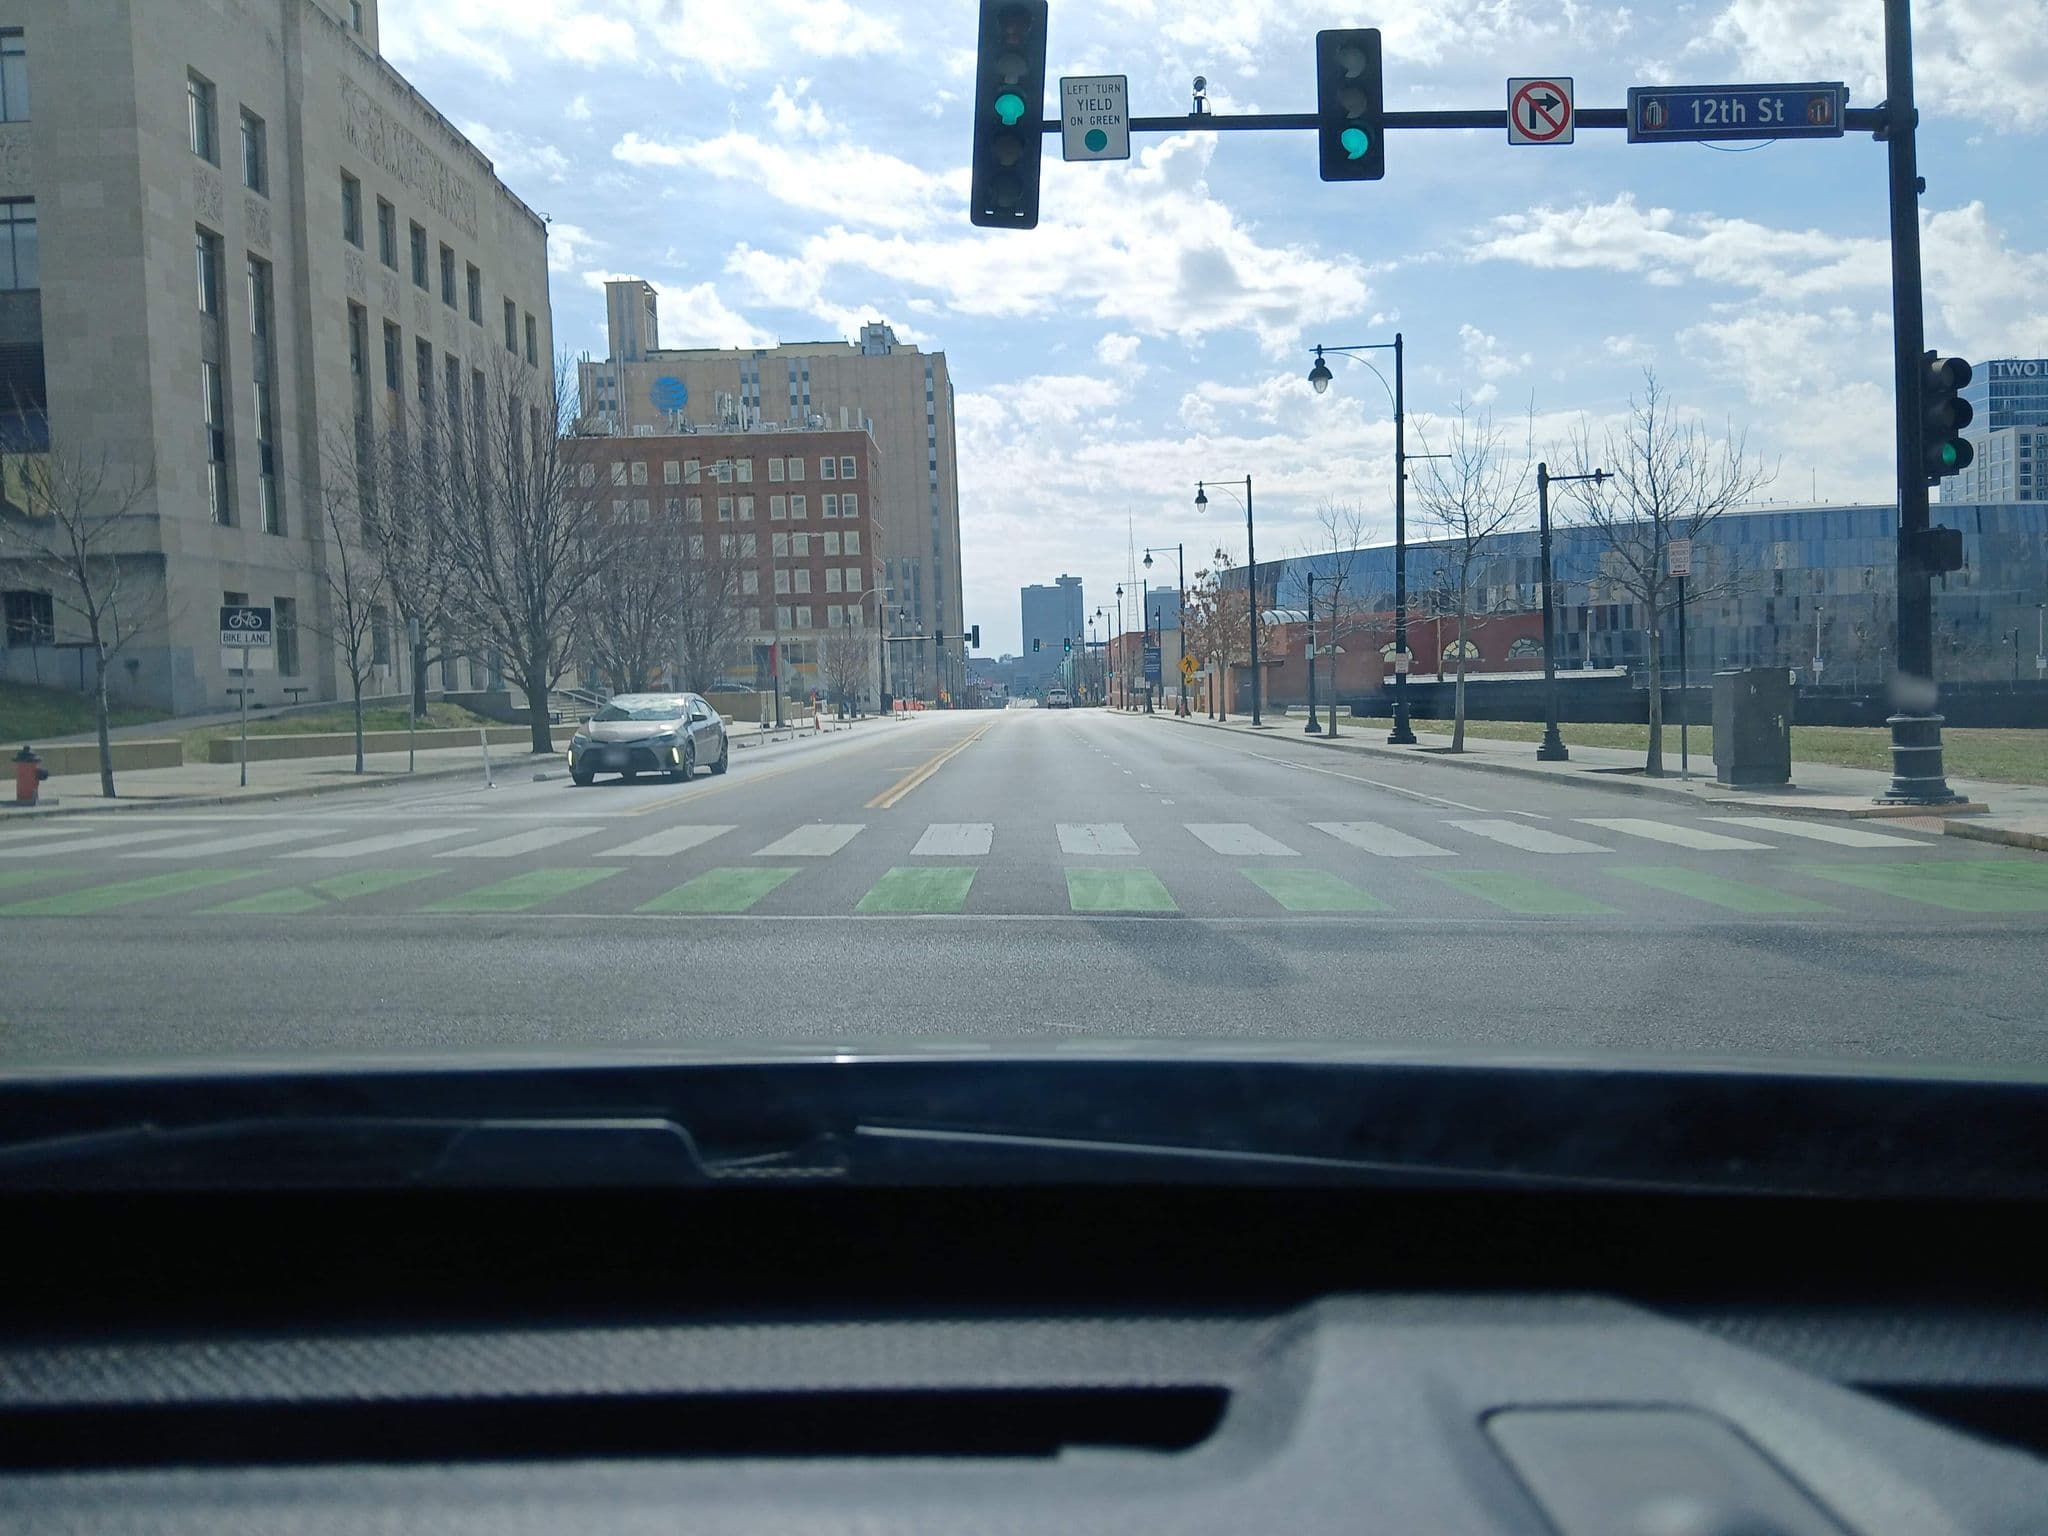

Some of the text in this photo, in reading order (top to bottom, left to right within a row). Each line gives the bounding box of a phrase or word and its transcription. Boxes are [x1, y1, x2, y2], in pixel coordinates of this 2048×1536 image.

[1066, 83, 1121, 95] LEFT TURN
[1077, 98, 1113, 111] YIELD
[1691, 97, 1785, 124] 12th St
[1070, 115, 1120, 126] ON GREEN
[1994, 361, 2038, 377] TWO
[223, 633, 267, 643] BIKE LANE
